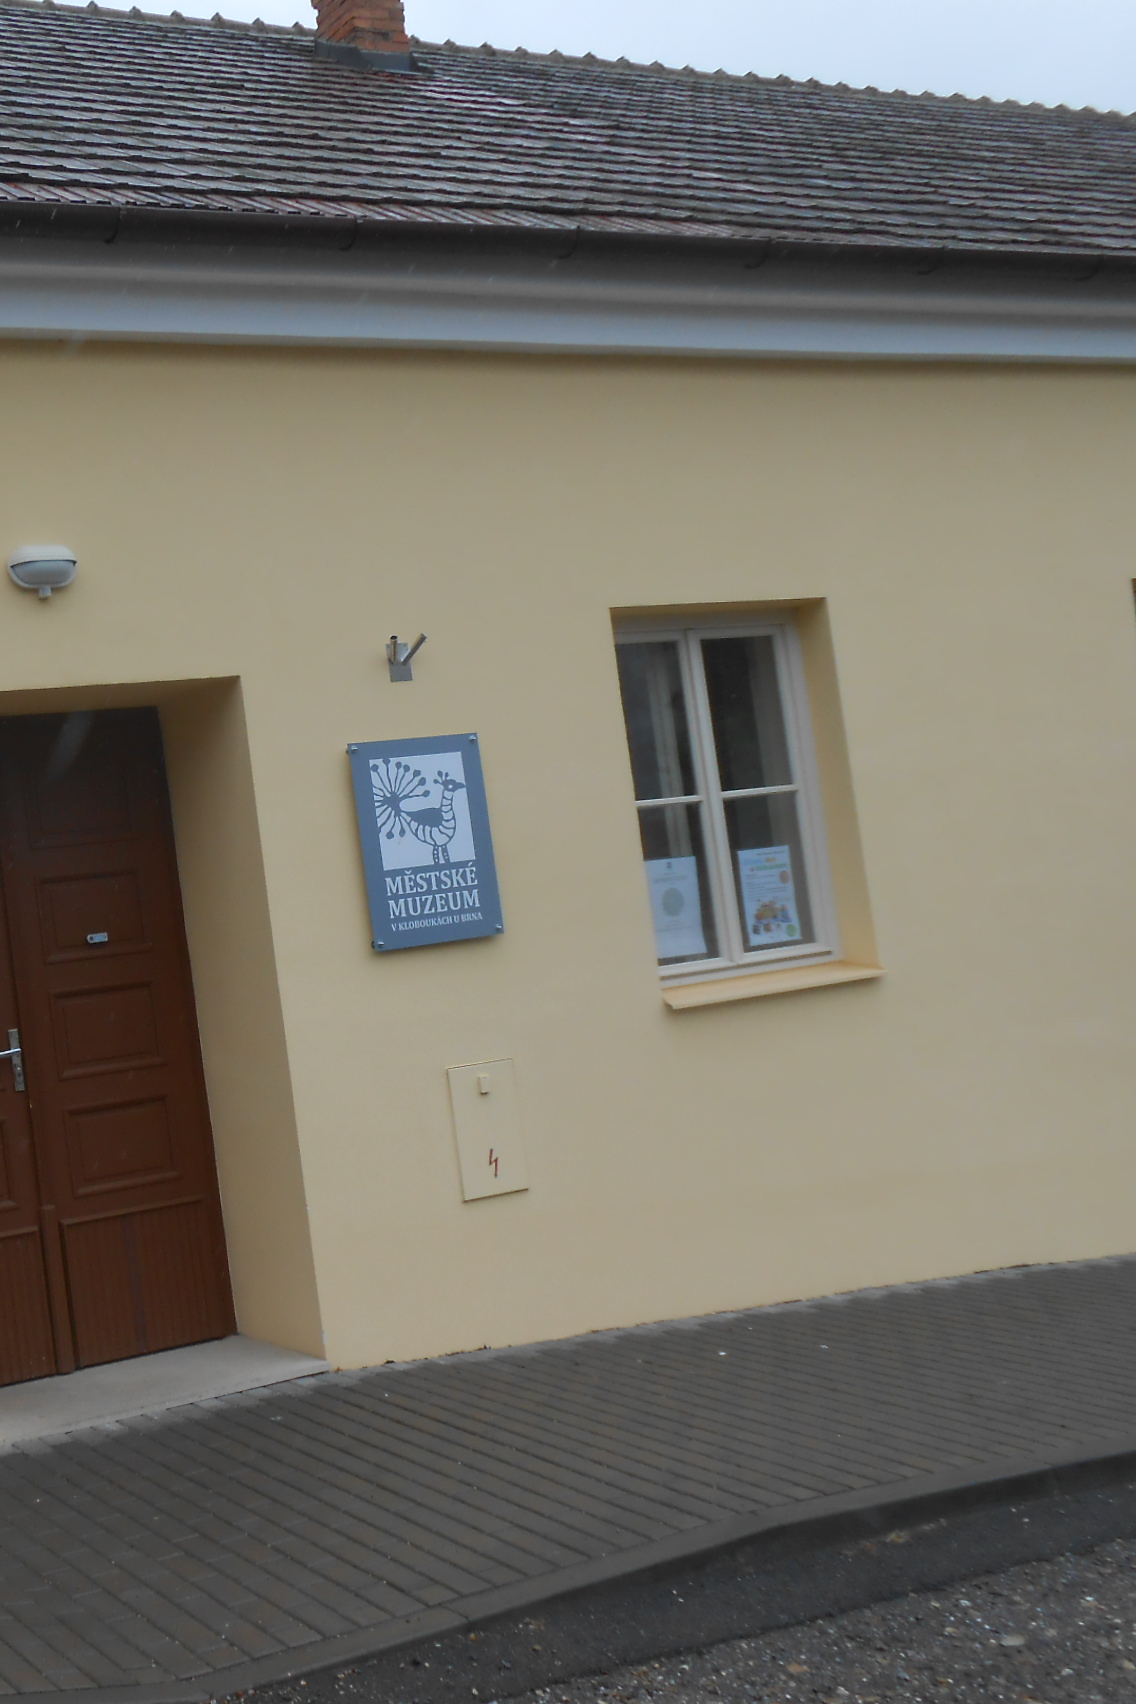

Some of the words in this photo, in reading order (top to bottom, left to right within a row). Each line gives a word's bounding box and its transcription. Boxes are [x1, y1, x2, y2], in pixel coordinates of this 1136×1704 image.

[385, 862, 478, 896] MĚSTSKÉ
[388, 889, 480, 919] MUZEUM
[391, 923, 398, 932] V
[398, 917, 452, 931] KLOBOUKÁCH
[453, 915, 460, 923] U
[461, 912, 483, 921] BRNA
